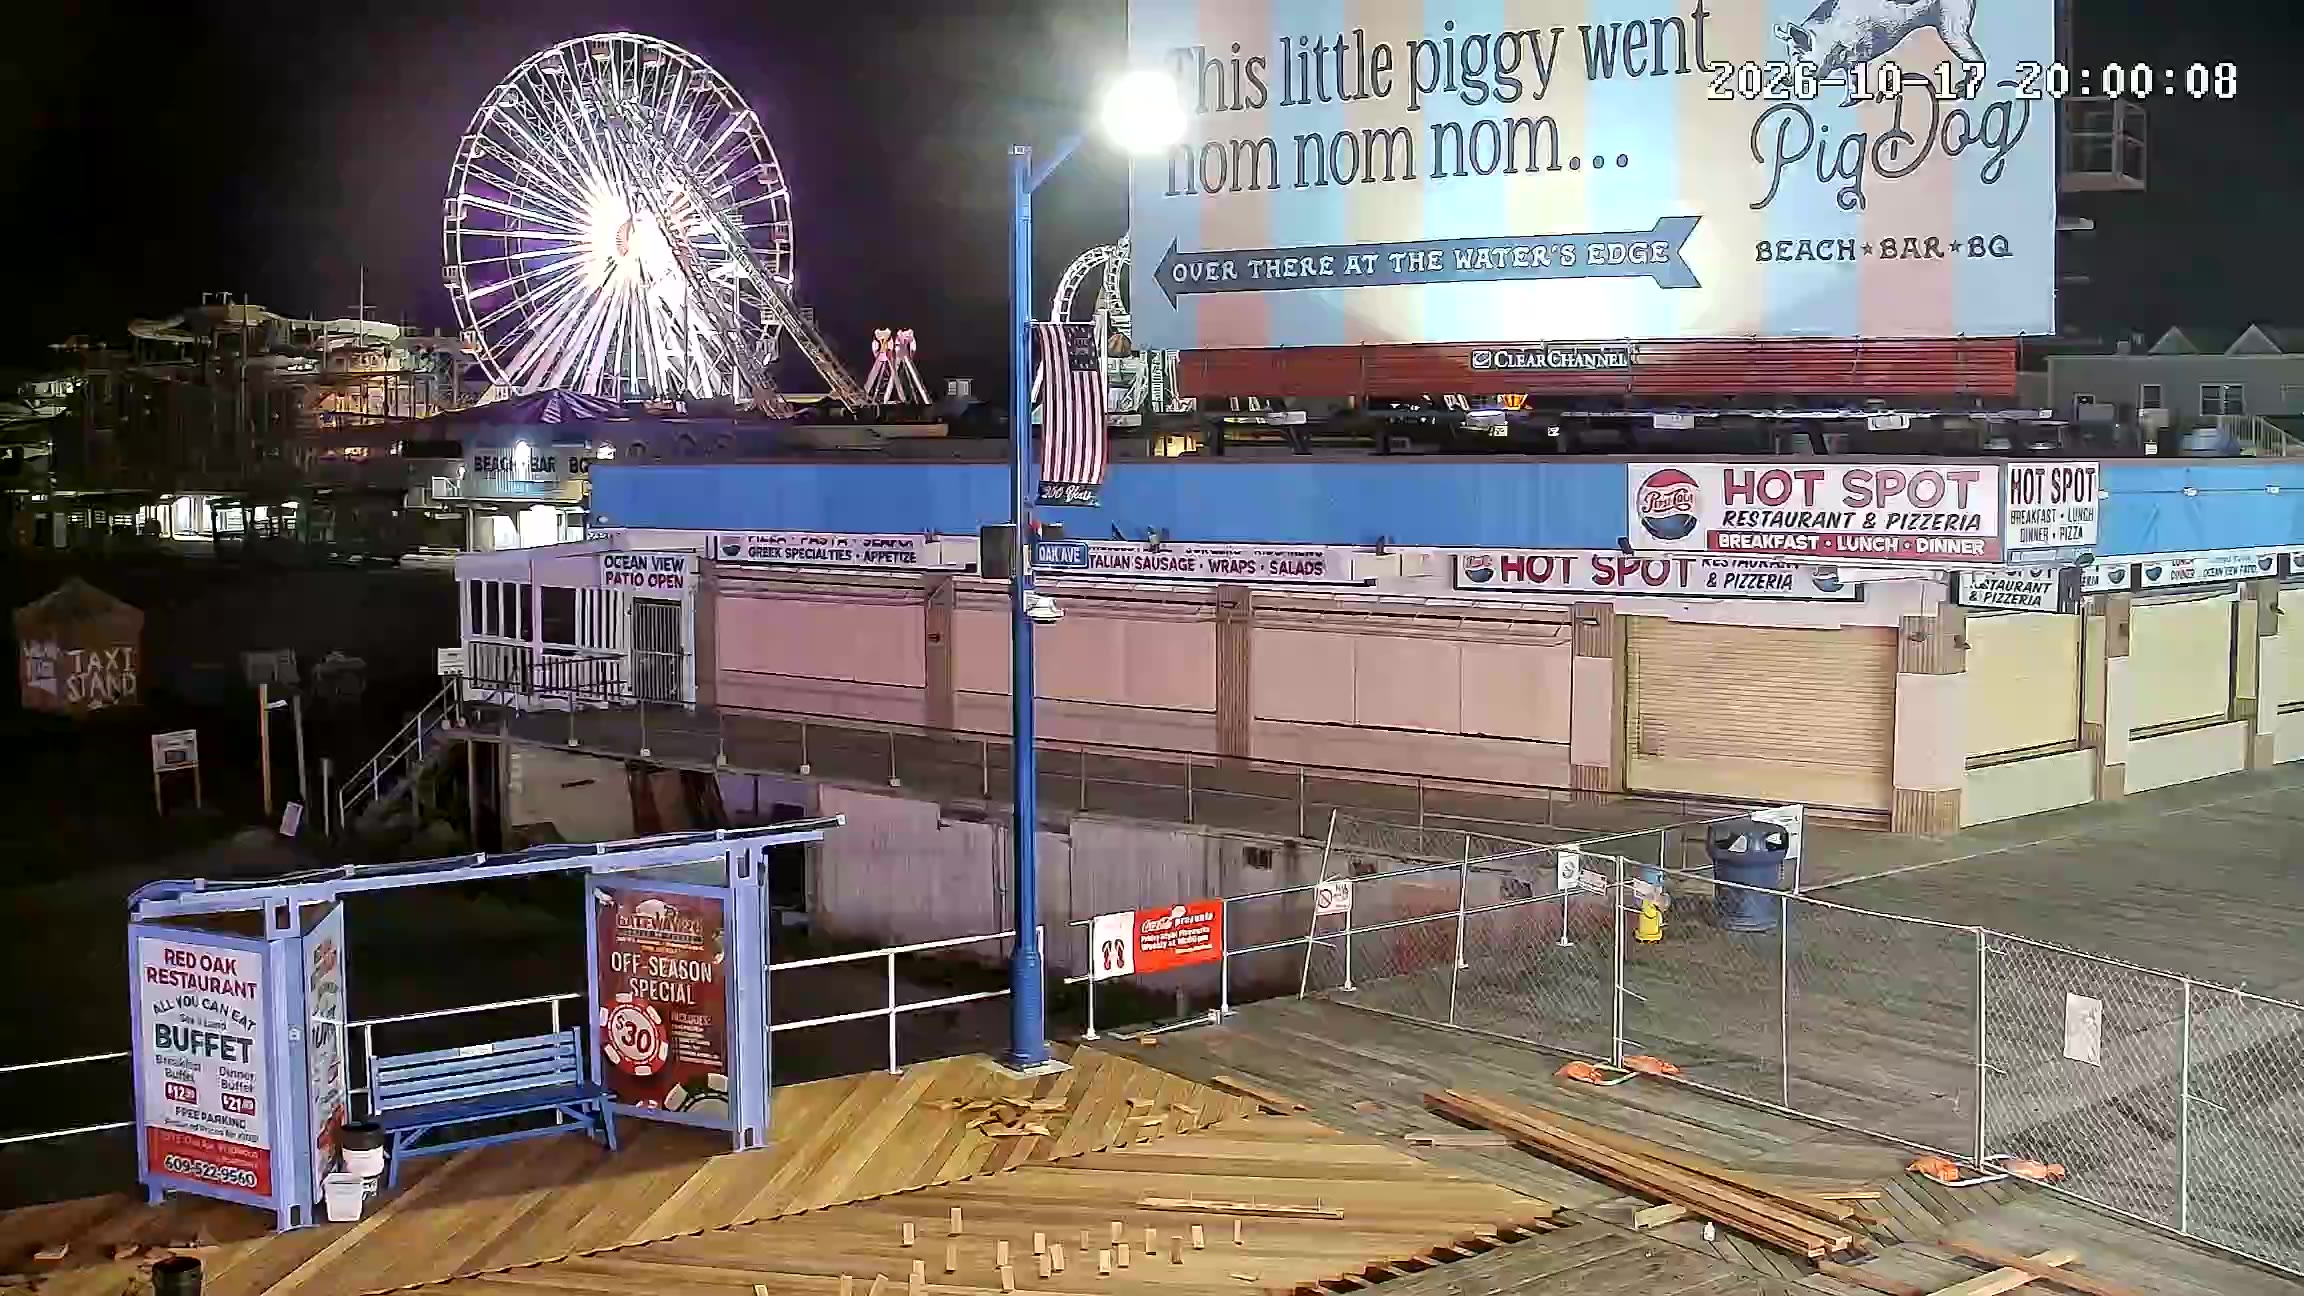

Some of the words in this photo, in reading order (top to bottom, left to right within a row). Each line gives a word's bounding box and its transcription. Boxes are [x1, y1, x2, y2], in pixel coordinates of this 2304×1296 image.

[1280, 28, 1394, 107] little
[1406, 19, 1565, 112] piggy
[1577, 0, 1716, 81] went
[1165, 136, 1281, 197] nom
[1293, 125, 1417, 188] nom
[1755, 238, 1856, 262] BEACH
[1880, 236, 1945, 260] BAR
[1967, 234, 2013, 258] BQ
[1172, 260, 1238, 284] OVER
[1248, 254, 1335, 280] THERE
[1345, 252, 1380, 276] AT
[1388, 249, 1444, 274] THE
[1453, 243, 1577, 270] WATER'S
[1586, 240, 1670, 266] EDGE
[530, 456, 556, 473] BAR
[1723, 468, 1825, 507] HOT
[1841, 468, 1980, 510] SPOT
[2010, 468, 2046, 505] HOT
[2050, 467, 2096, 504] SPOT
[1722, 510, 1856, 530] RESTAURANT
[1863, 512, 1876, 529] &
[1886, 513, 1981, 532] PIZZERIA
[2010, 508, 2057, 525] BREAKFAST
[2067, 507, 2094, 523] LUNCH
[1719, 533, 1819, 551] BREAKFAST
[1837, 536, 1899, 554] LUNCH
[1915, 538, 1985, 556] DINNER
[2020, 527, 2049, 543] DINNER
[2060, 525, 2083, 541] PIZZA
[603, 555, 648, 570] OCEAN
[652, 556, 685, 572] VIEW
[748, 546, 783, 559] GREEK
[785, 547, 852, 561] SPECIALTIES
[1039, 545, 1059, 562] OAK
[1060, 546, 1081, 563] AVE
[1134, 555, 1196, 572] SAUSAGE
[1208, 558, 1256, 574] WRAPS
[1270, 559, 1324, 576] SALADS
[605, 572, 644, 587] PATIO
[648, 573, 684, 589] OPEN
[1501, 554, 1579, 585] HOT
[1592, 554, 1691, 588] SPOT
[1706, 571, 1717, 588] &
[1724, 572, 1793, 591] PIZZERIA
[1983, 591, 2041, 607] PIZZERIA
[66, 646, 137, 672] TAXI
[66, 671, 137, 704] STAND
[164, 948, 197, 969] RED
[200, 954, 238, 976] OAK
[145, 966, 258, 1000] RESTAURANT
[630, 976, 697, 1006] SPECIAL
[152, 1000, 175, 1015] ALL
[176, 995, 199, 1009] YOU
[201, 998, 230, 1017] CAN
[231, 1009, 257, 1032] EAT
[154, 1023, 254, 1064] BUFFET
[175, 1106, 199, 1121] FREE
[201, 1110, 246, 1130] PARKING
